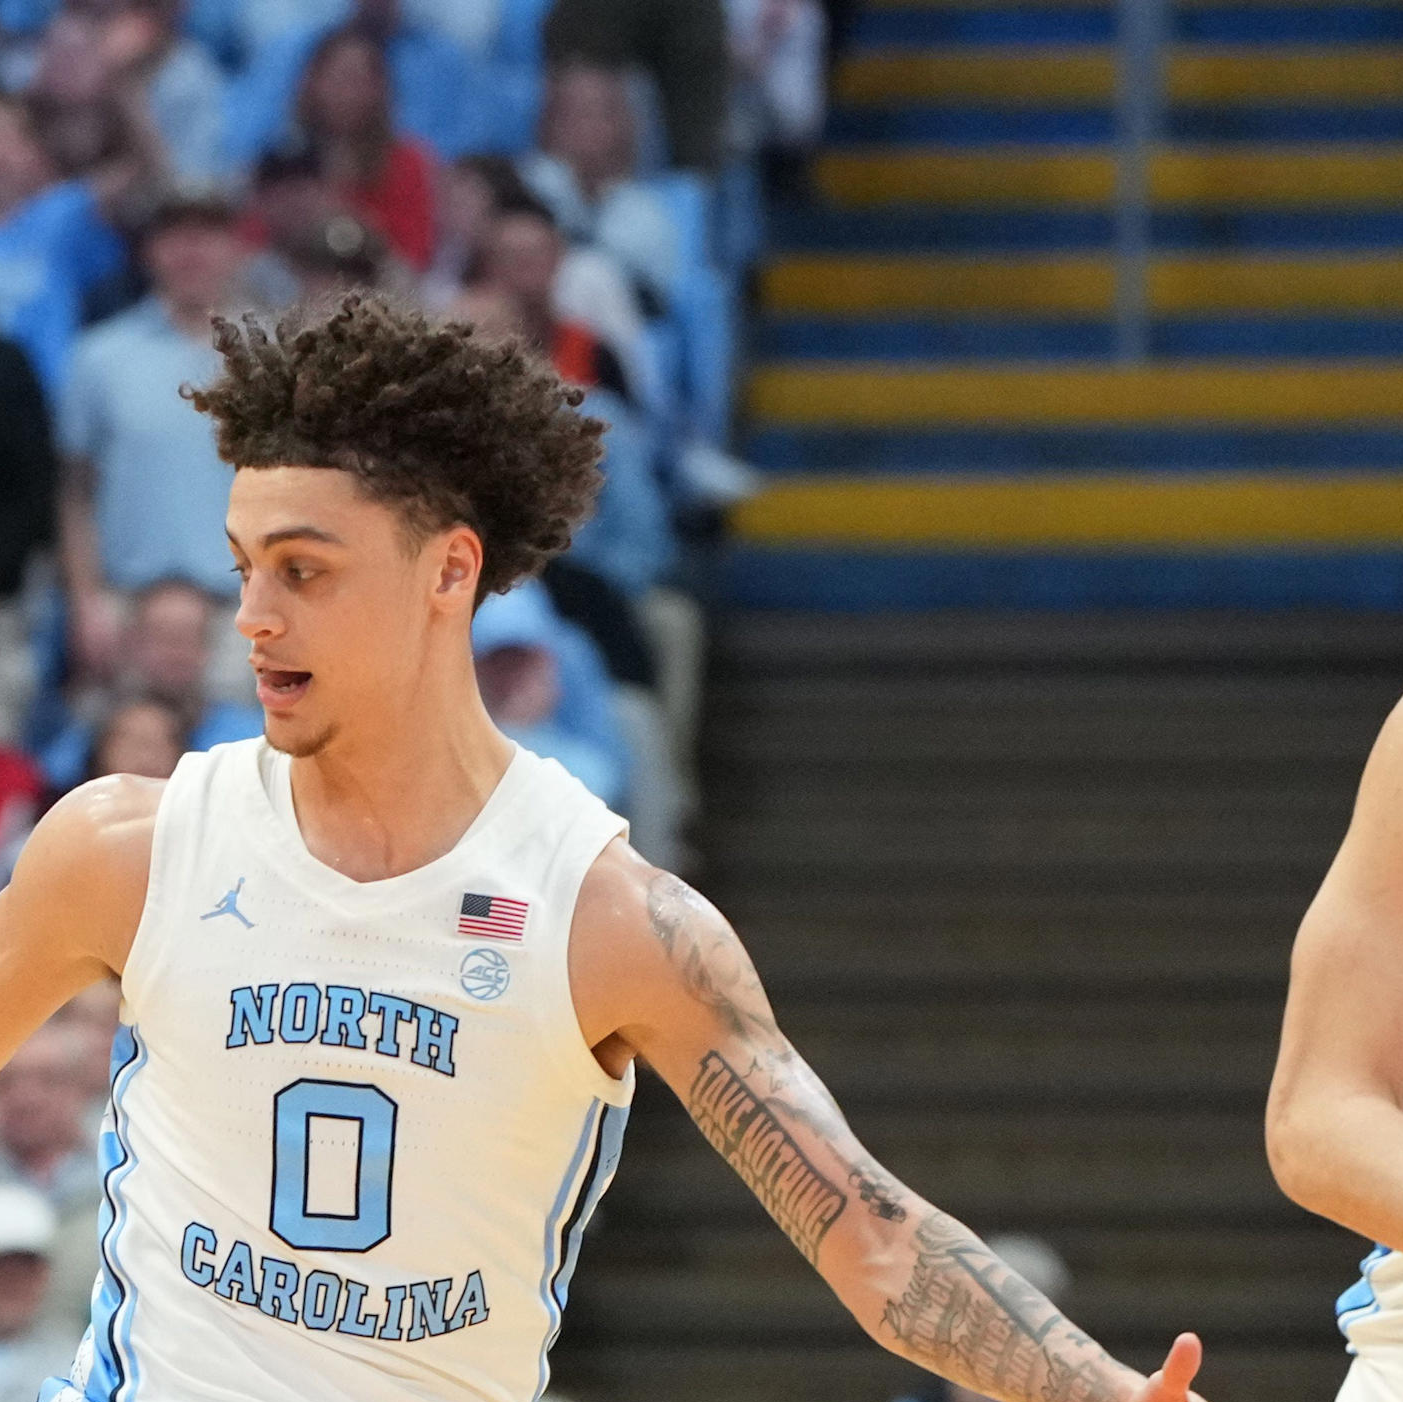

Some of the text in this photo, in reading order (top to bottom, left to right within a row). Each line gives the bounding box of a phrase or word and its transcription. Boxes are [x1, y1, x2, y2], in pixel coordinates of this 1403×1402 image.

[226, 983, 458, 1076] NORTH
[269, 1078, 398, 1252] 0
[181, 1222, 490, 1341] CAROLINA
